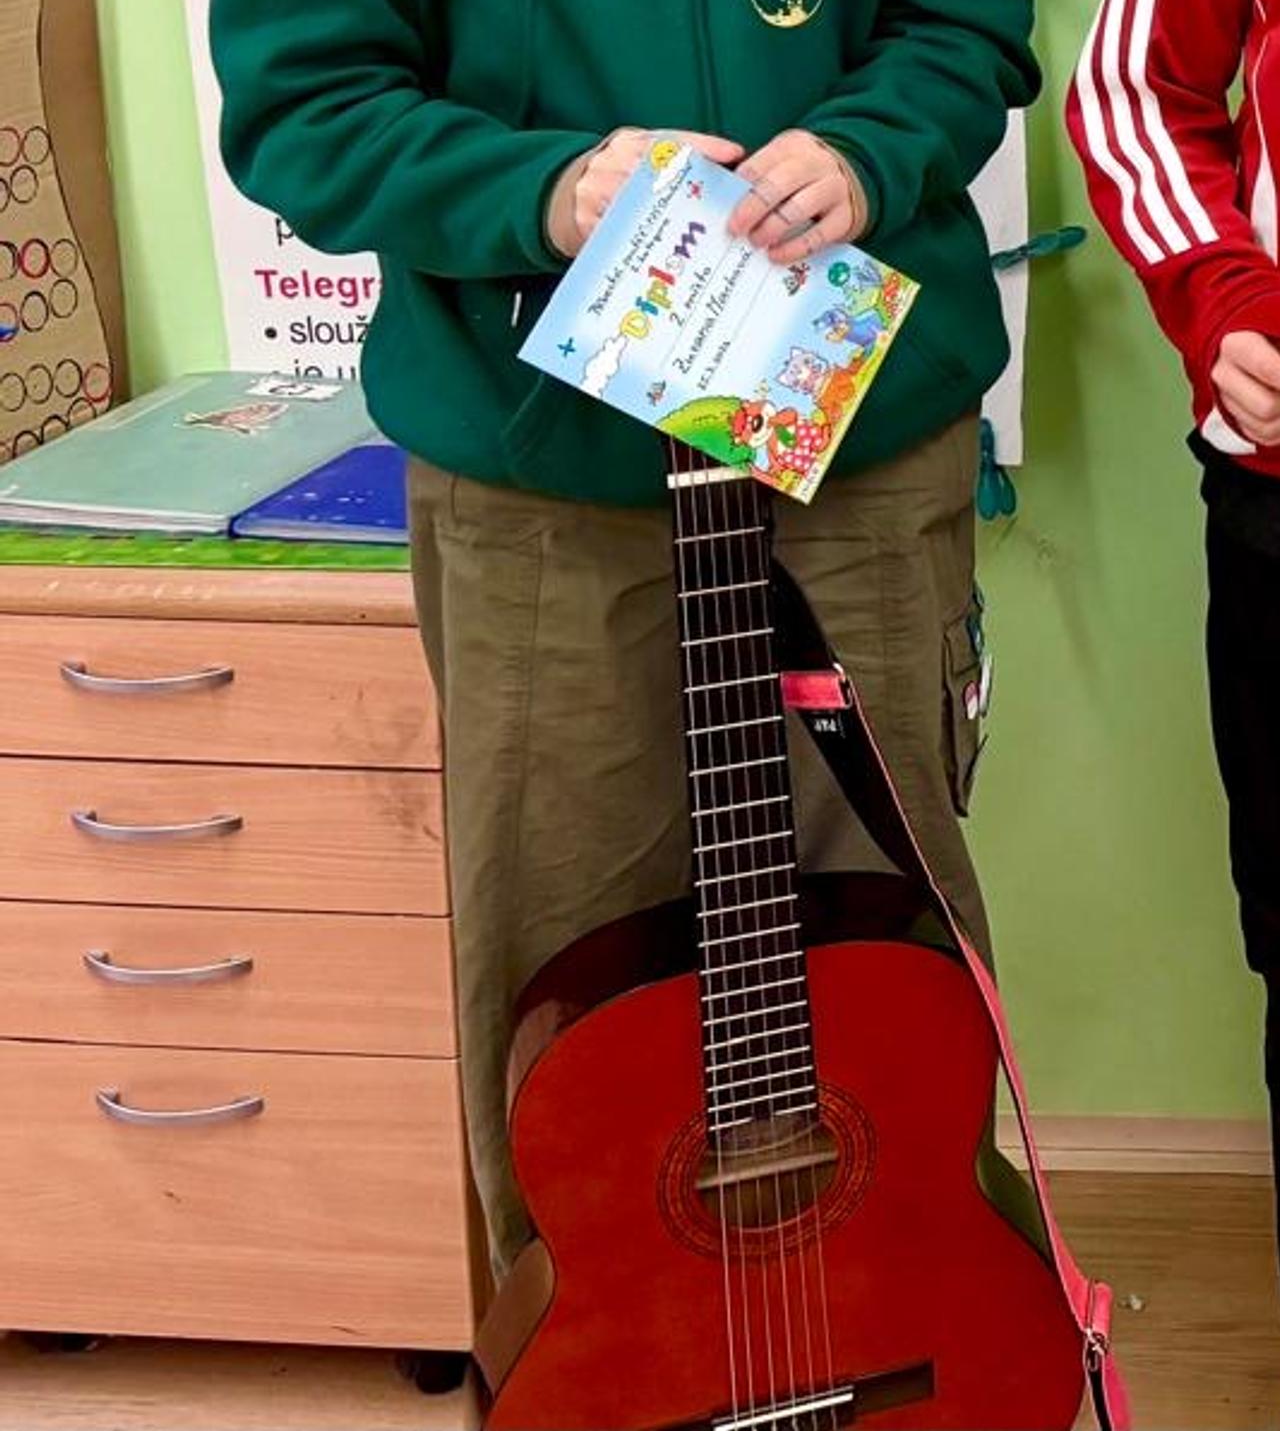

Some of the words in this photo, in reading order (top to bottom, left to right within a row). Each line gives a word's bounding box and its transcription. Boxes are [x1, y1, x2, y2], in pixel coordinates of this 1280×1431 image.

[254, 270, 382, 306] Telegr
[618, 221, 707, 340] Diplom
[290, 314, 368, 344] slouž
